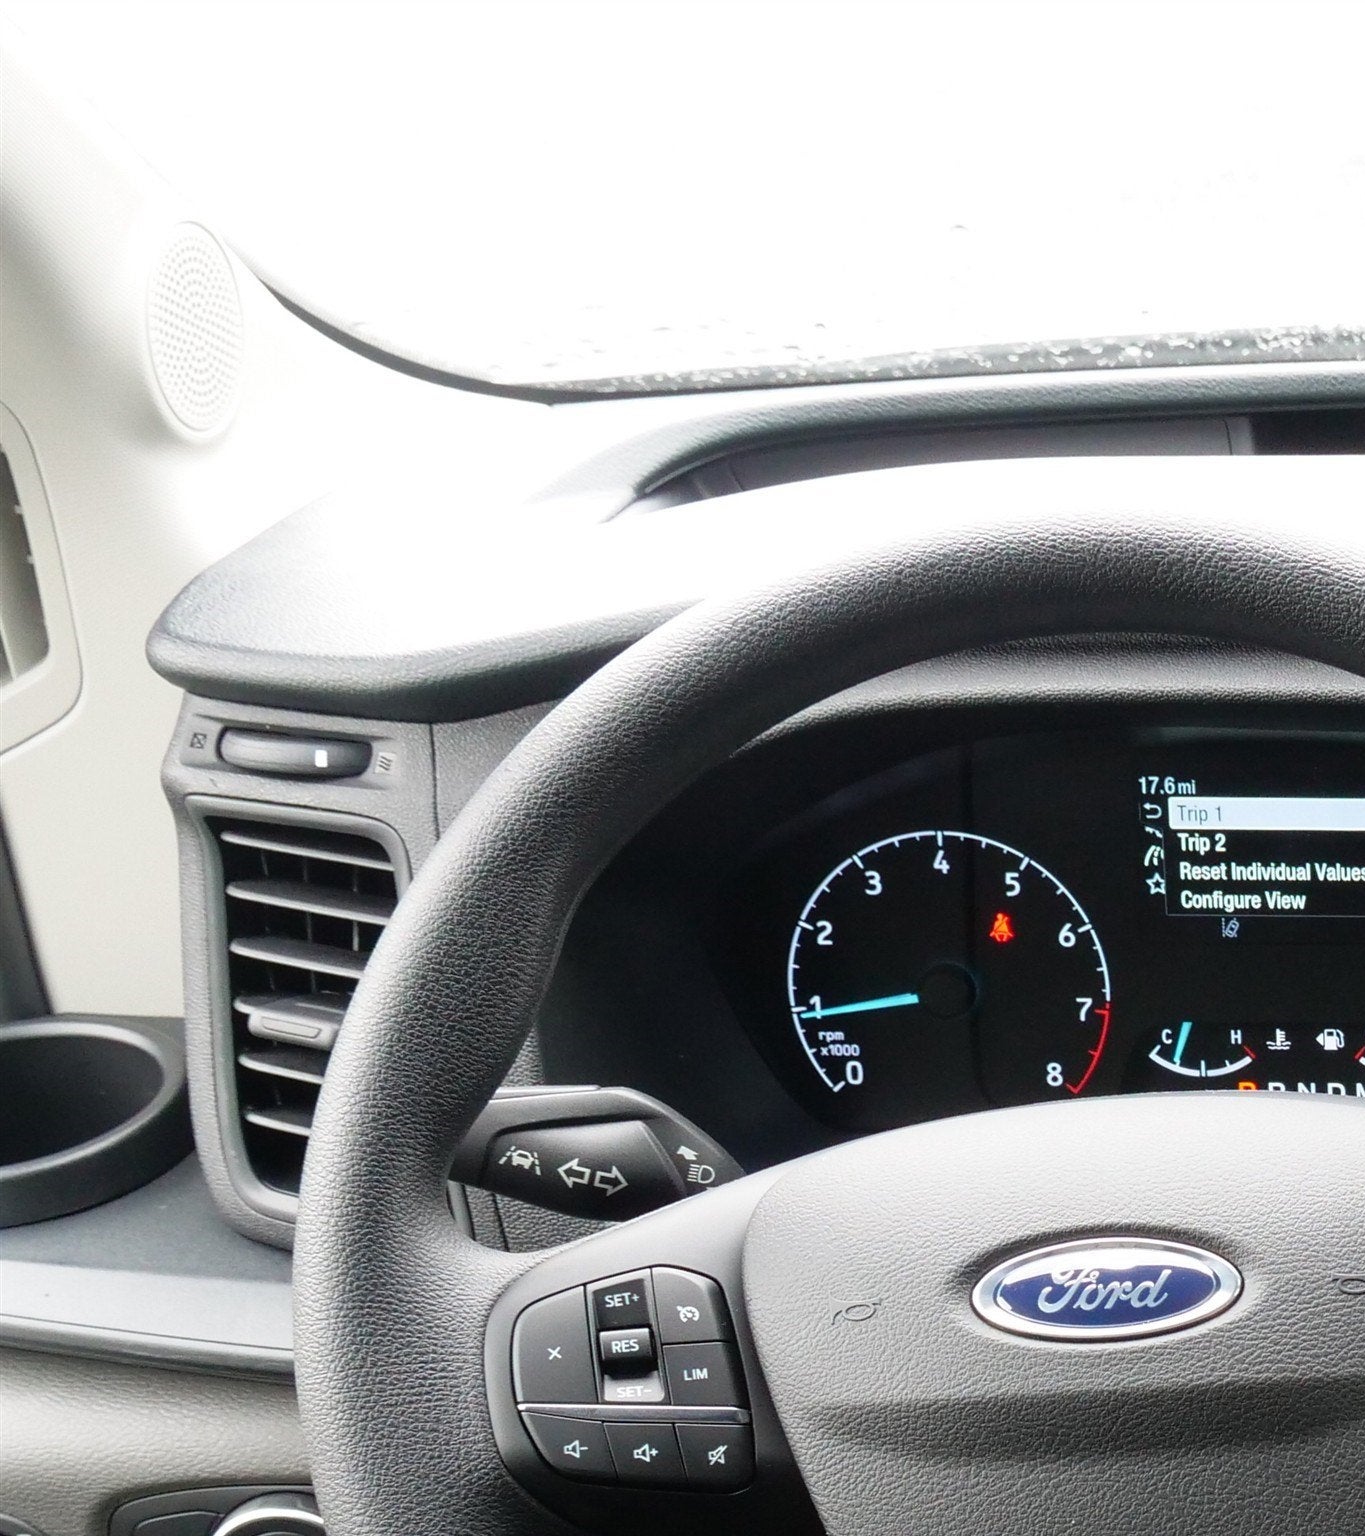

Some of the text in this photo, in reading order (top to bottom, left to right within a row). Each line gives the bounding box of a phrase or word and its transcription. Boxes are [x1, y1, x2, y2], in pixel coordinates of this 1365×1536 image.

[1177, 805, 1221, 825] Trip 1
[1177, 833, 1226, 855] Trip 2
[933, 850, 950, 874] 4
[1180, 862, 1227, 880] Reset
[1232, 863, 1311, 881] Individual
[865, 871, 882, 895] 3
[1006, 873, 1020, 896] 5
[1181, 891, 1306, 912] Configure View
[815, 921, 833, 945] 2
[1059, 923, 1075, 947] 6
[1076, 998, 1092, 1021] 7
[819, 1032, 844, 1042] rpm
[1161, 1029, 1173, 1045] C
[1231, 1030, 1241, 1044] H
[822, 1045, 859, 1055] x1000
[845, 1061, 864, 1085] 0
[1047, 1063, 1062, 1086] 8
[605, 1292, 639, 1307] SET+
[1038, 1266, 1172, 1314] Ford
[612, 1340, 639, 1353] RES
[684, 1368, 708, 1380] LIM
